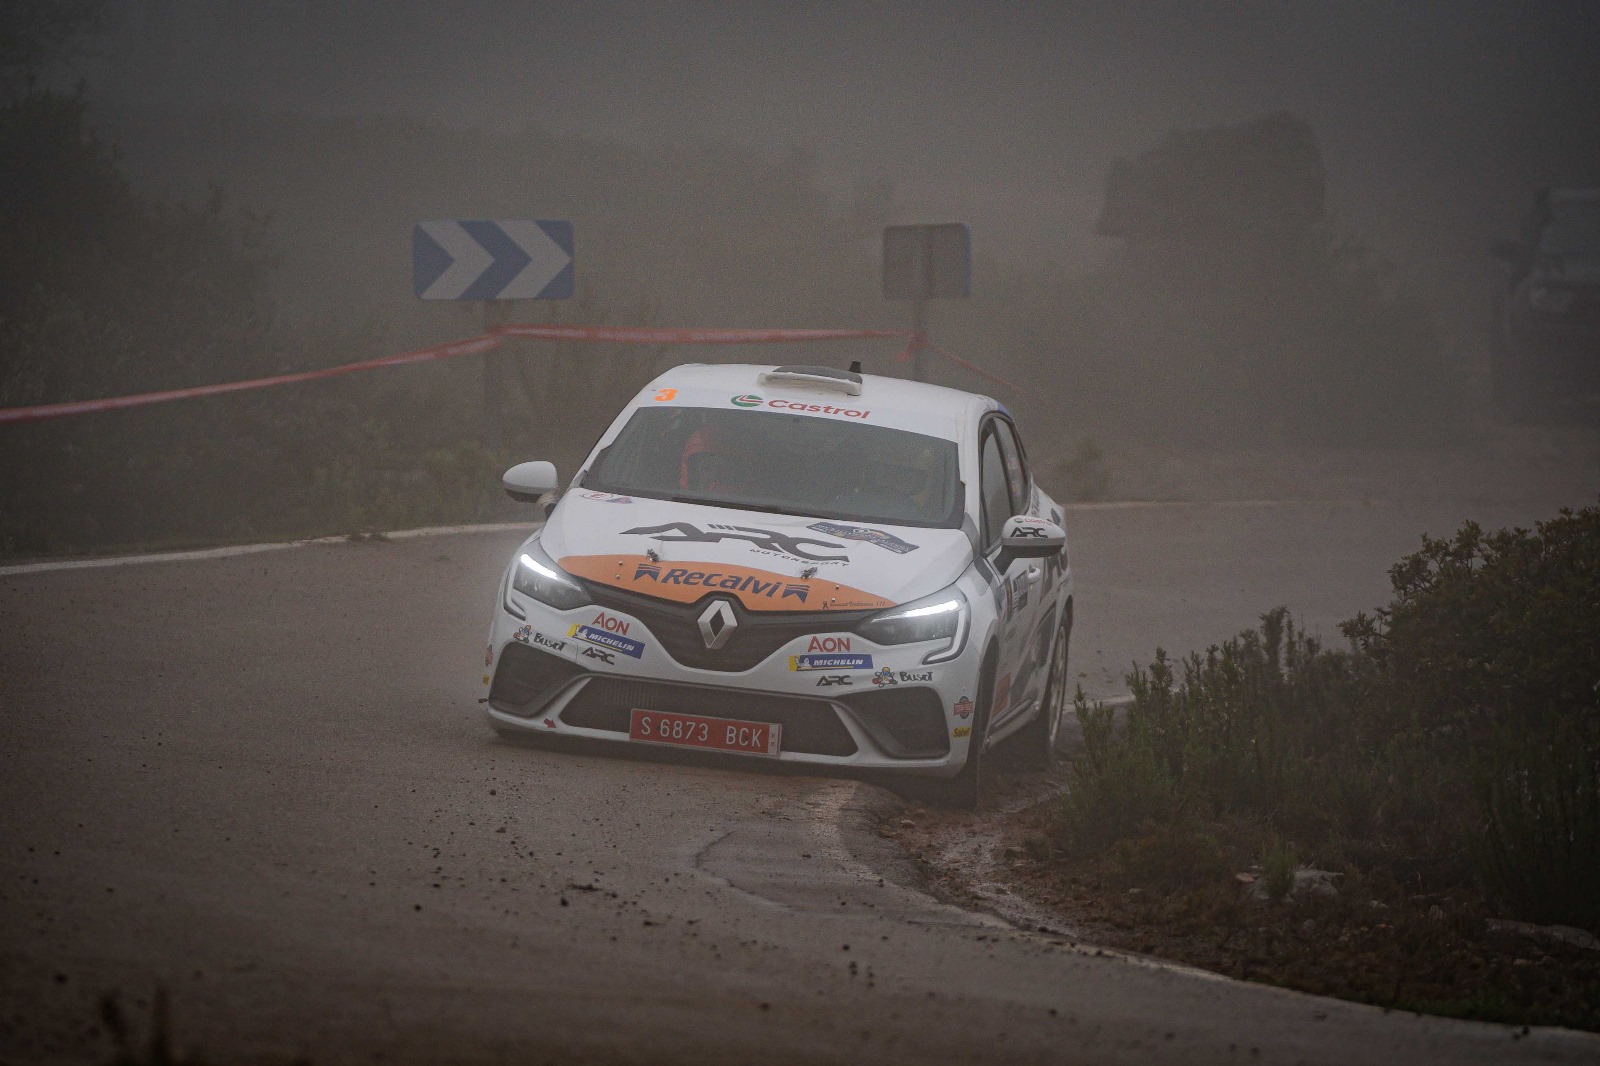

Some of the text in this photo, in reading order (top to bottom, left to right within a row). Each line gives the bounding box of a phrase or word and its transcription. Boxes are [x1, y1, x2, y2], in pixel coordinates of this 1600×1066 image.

[654, 388, 678, 402] 3
[767, 399, 871, 419] Castrol
[618, 521, 850, 563] ARC
[1009, 526, 1049, 539] ARC
[660, 568, 783, 597] Recalvi
[591, 612, 630, 636] AON
[588, 632, 635, 651] MICHELIN
[807, 635, 850, 653] AON
[581, 646, 615, 665] ARC
[813, 658, 864, 666] MICHELIN
[816, 674, 853, 687] ARC
[641, 716, 651, 735] S
[659, 718, 709, 742] 6873
[725, 725, 763, 748] BCK
